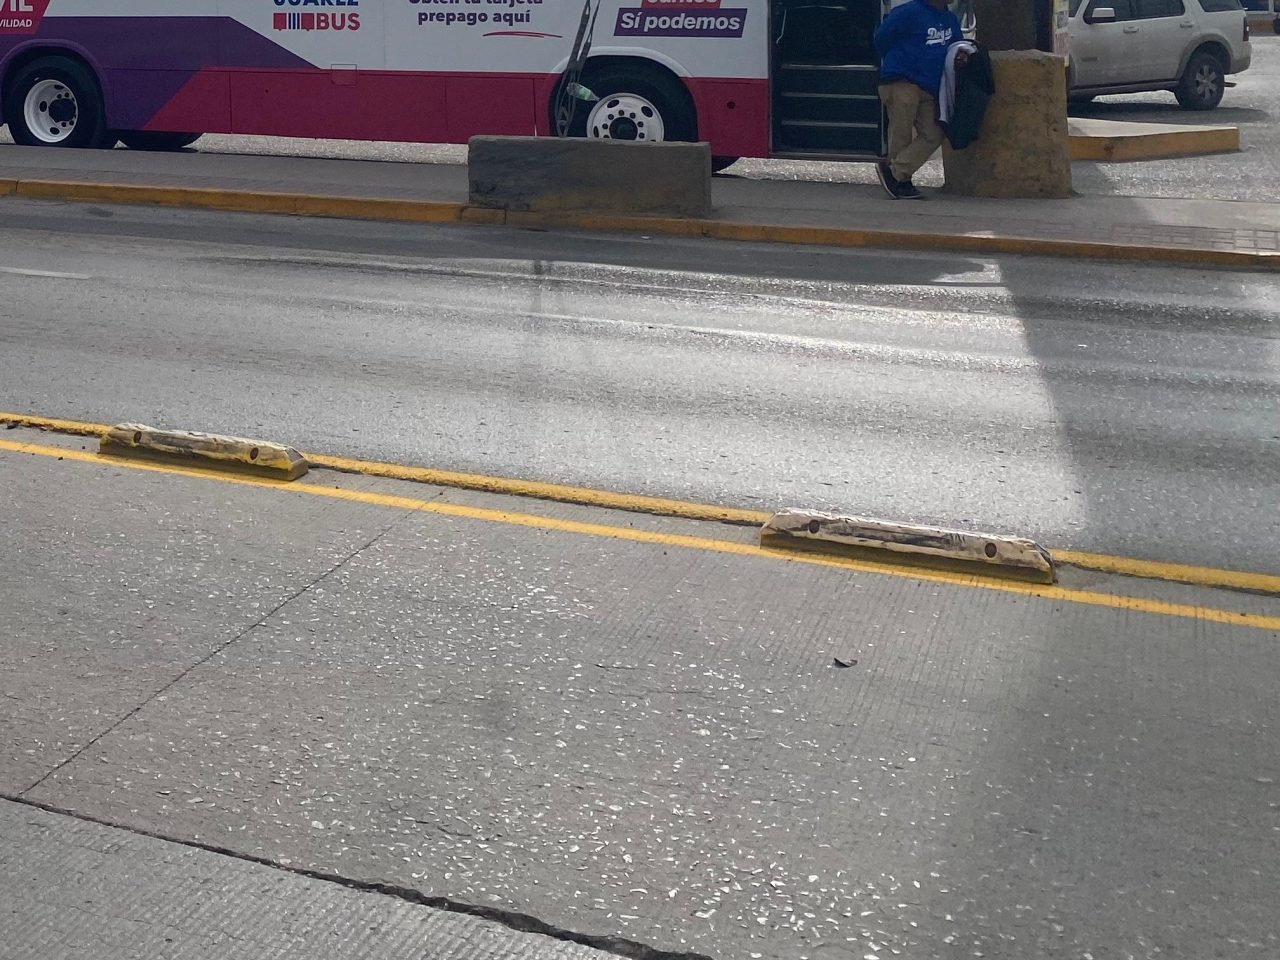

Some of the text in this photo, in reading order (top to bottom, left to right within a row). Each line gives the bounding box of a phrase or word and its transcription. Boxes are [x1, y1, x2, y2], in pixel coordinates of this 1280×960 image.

[316, 12, 361, 31] BUS
[418, 10, 531, 27] prepago aquí
[620, 11, 741, 32] Sí podemos
